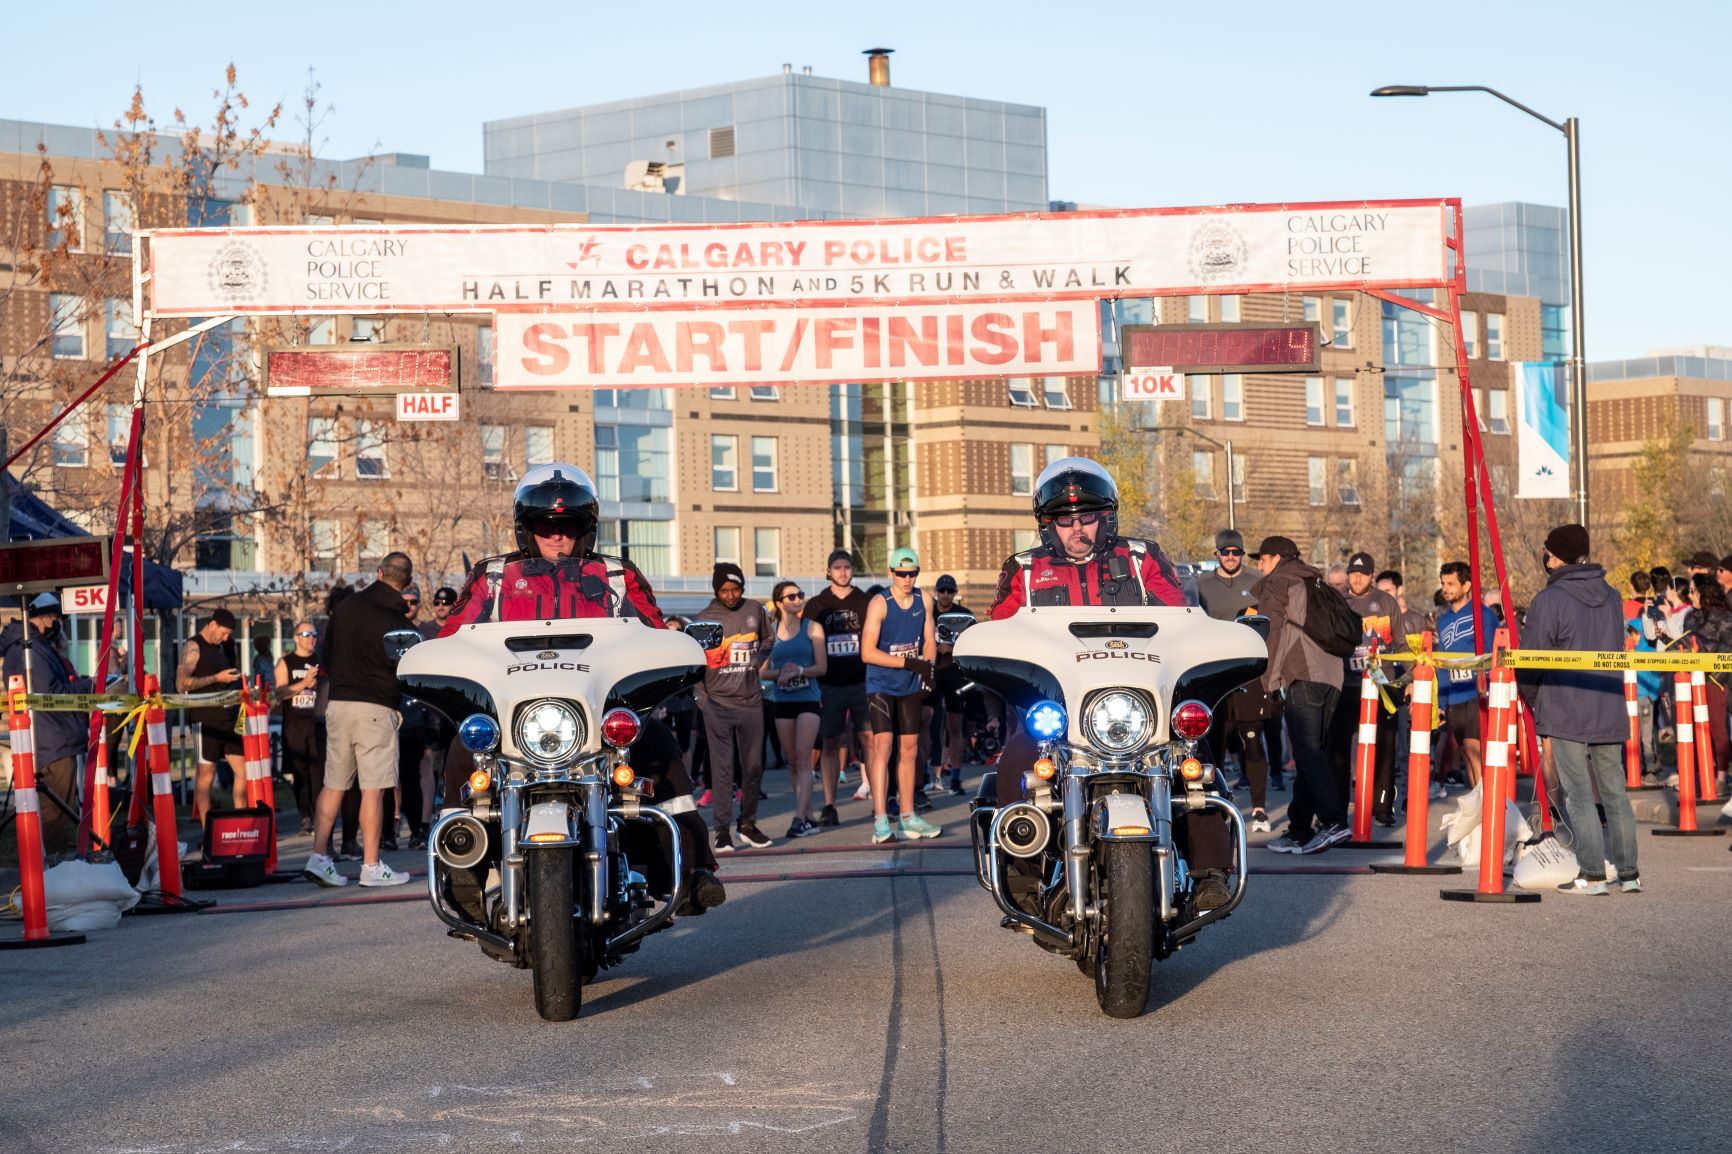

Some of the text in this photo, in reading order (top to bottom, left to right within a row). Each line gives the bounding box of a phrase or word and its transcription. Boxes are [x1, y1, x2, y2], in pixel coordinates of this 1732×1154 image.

[1288, 213, 1389, 234] CALGARY
[307, 239, 408, 258] CALGARY
[625, 236, 967, 270] CALGARY POLICE
[1287, 235, 1363, 256] POLICE
[307, 260, 383, 279] POLICE
[1287, 257, 1371, 277] SERVICE
[306, 281, 391, 300] SERVICE
[462, 266, 1132, 301] HALF MARATHON AND 5K RUN & WALK
[521, 311, 1073, 375] START/FINISH
[1130, 375, 1176, 395] 10K
[403, 396, 453, 414] HALF
[74, 587, 105, 607] 5K
[829, 642, 857, 652] 1117
[1076, 652, 1161, 664] POLICE
[1603, 661, 1613, 669] NOT
[1613, 661, 1631, 669] CROSS
[507, 663, 591, 676] POLICE
